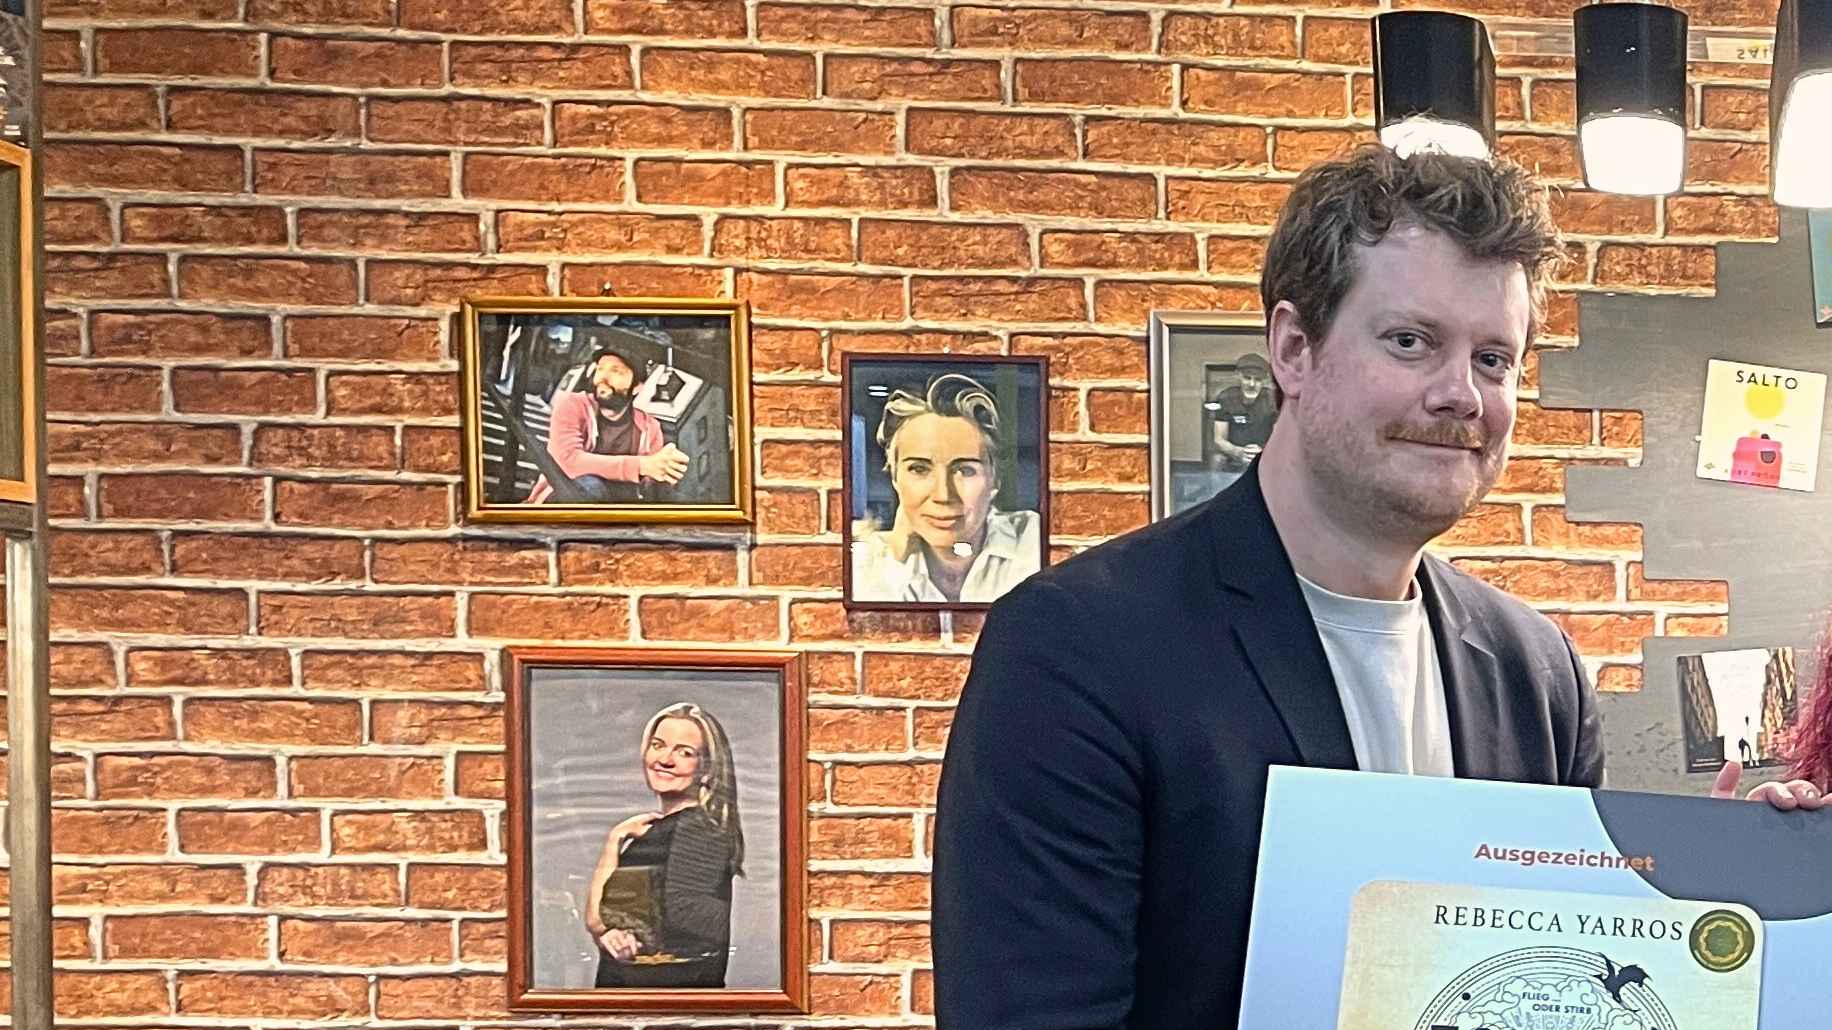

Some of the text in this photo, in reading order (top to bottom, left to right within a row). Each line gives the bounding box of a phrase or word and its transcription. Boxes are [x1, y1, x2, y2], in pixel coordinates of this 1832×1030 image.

[1734, 369, 1799, 391] SALTO
[1474, 843, 1656, 872] Ausgezeichnet
[1434, 904, 1684, 941] REBECCA YARROS
[1521, 991, 1551, 1002] FLIEG
[1531, 1003, 1593, 1015] ODER STIRB
